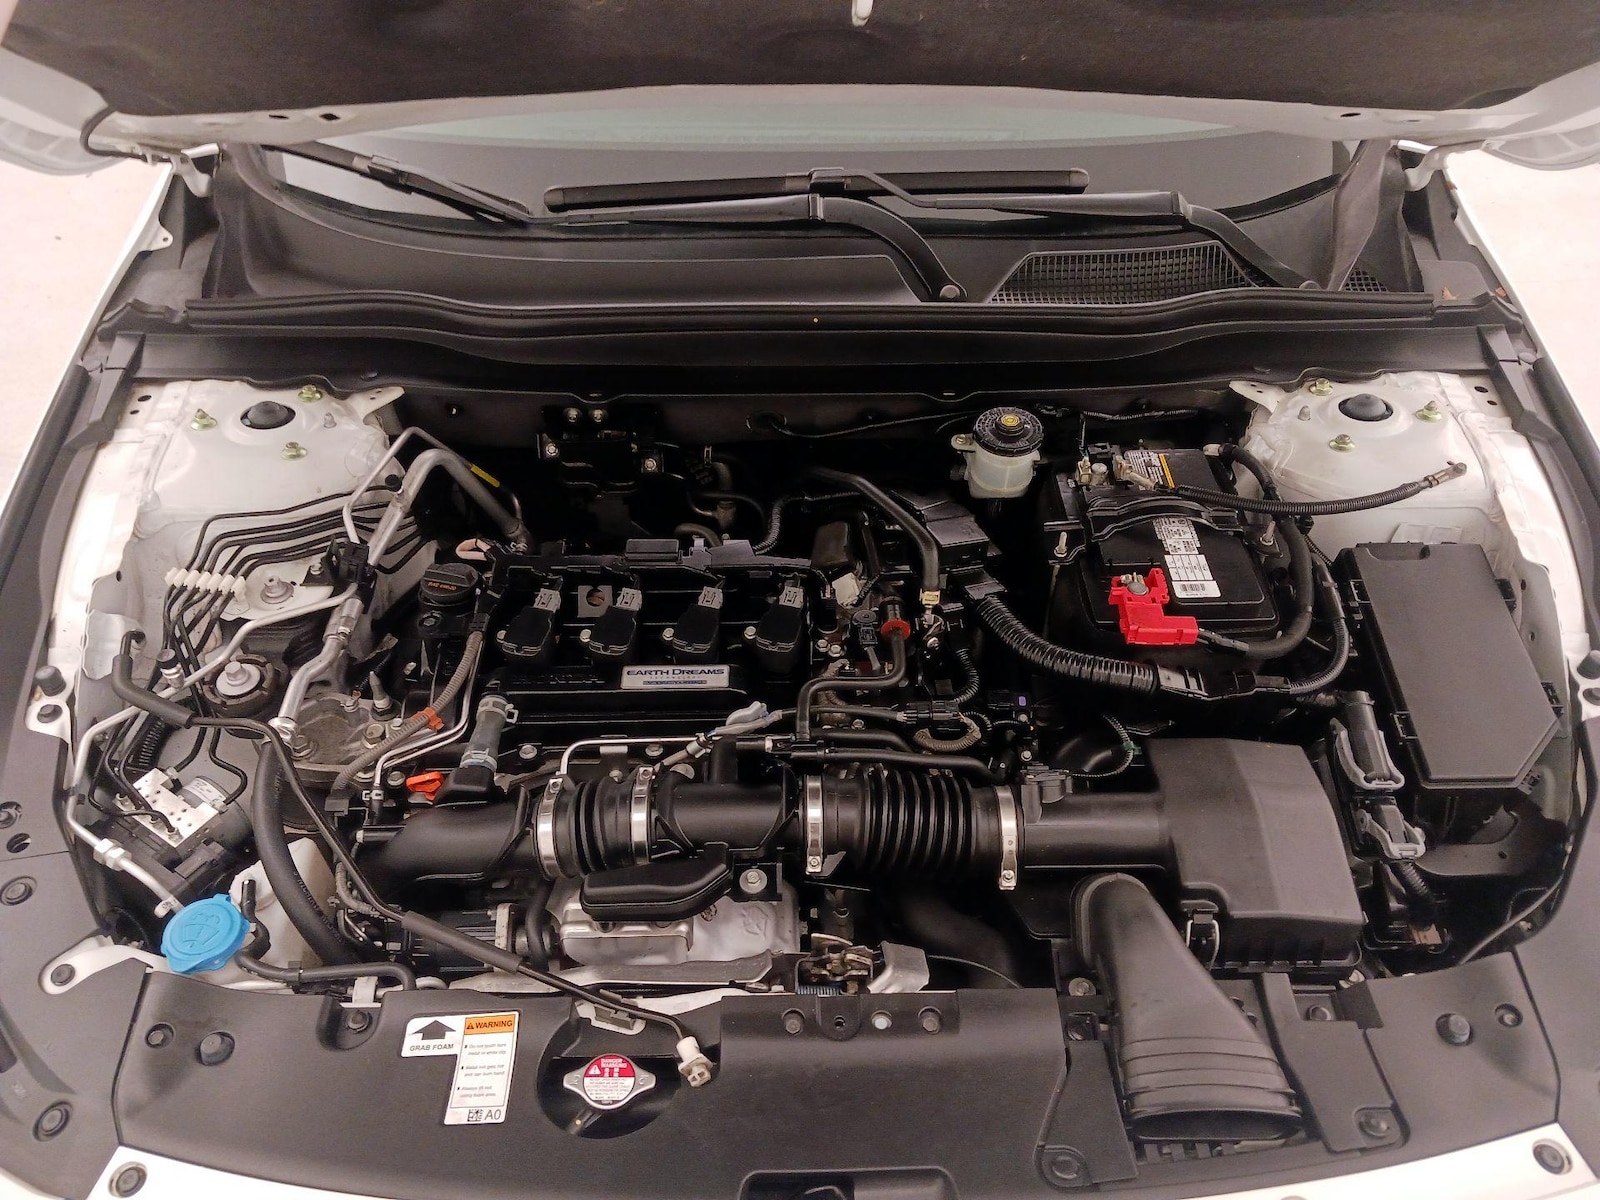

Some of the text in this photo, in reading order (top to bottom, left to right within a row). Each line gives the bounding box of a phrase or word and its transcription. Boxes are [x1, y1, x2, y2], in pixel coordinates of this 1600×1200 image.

[475, 1020, 513, 1028] WARNING
[432, 1043, 454, 1051] FOAM
[484, 1109, 502, 1121] A0
